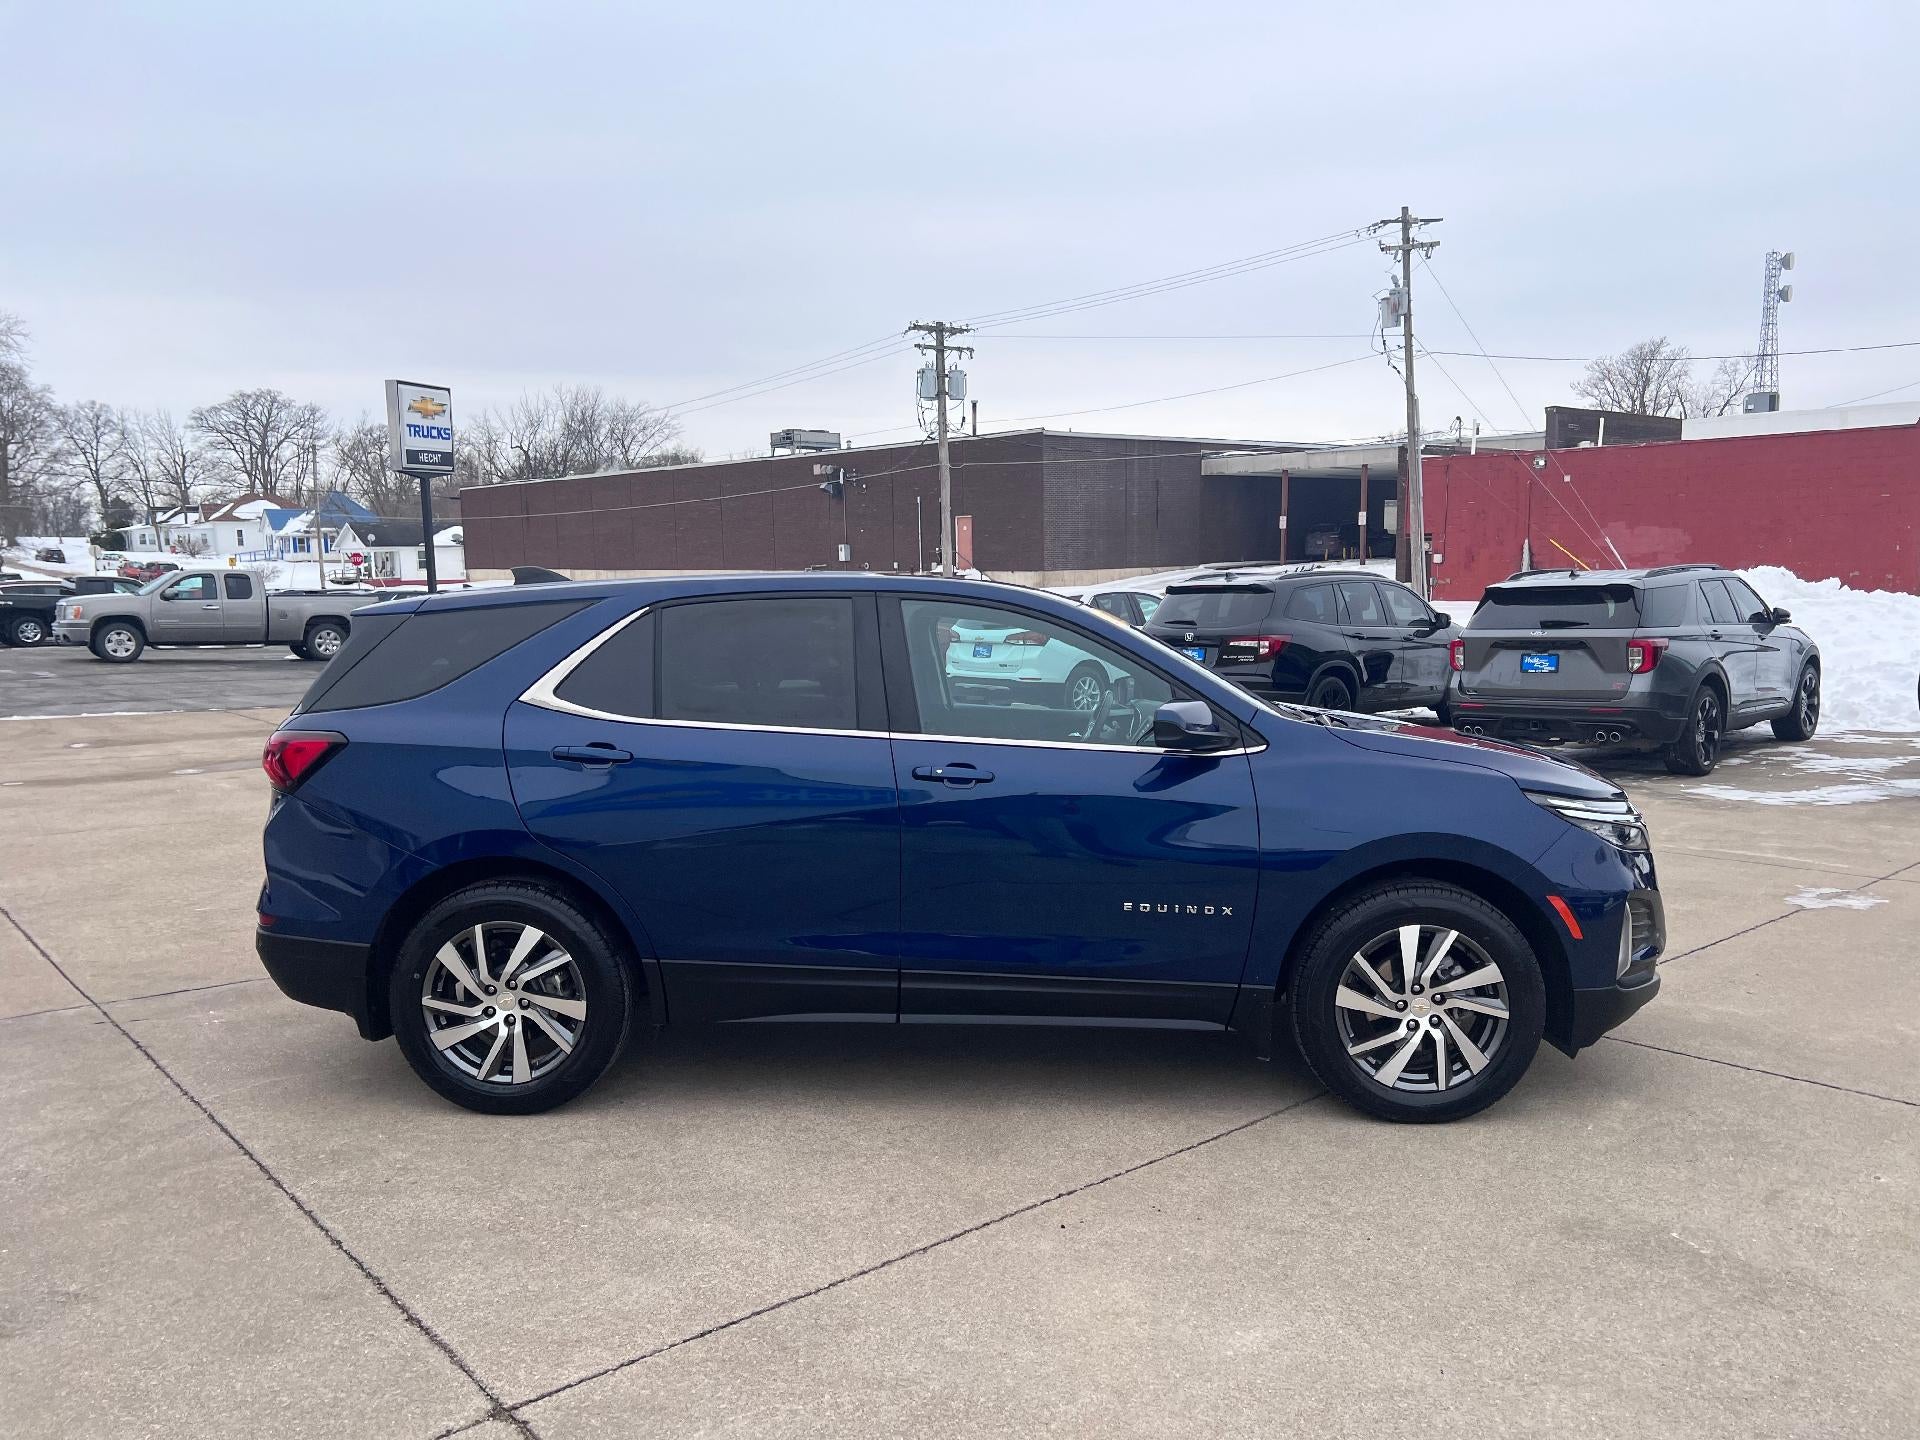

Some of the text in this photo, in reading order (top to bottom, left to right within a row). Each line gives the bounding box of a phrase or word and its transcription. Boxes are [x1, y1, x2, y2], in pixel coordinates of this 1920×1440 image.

[406, 423, 451, 441] TRUCKS
[418, 452, 442, 463] HECHT
[1123, 902, 1233, 916] EQUINOX
